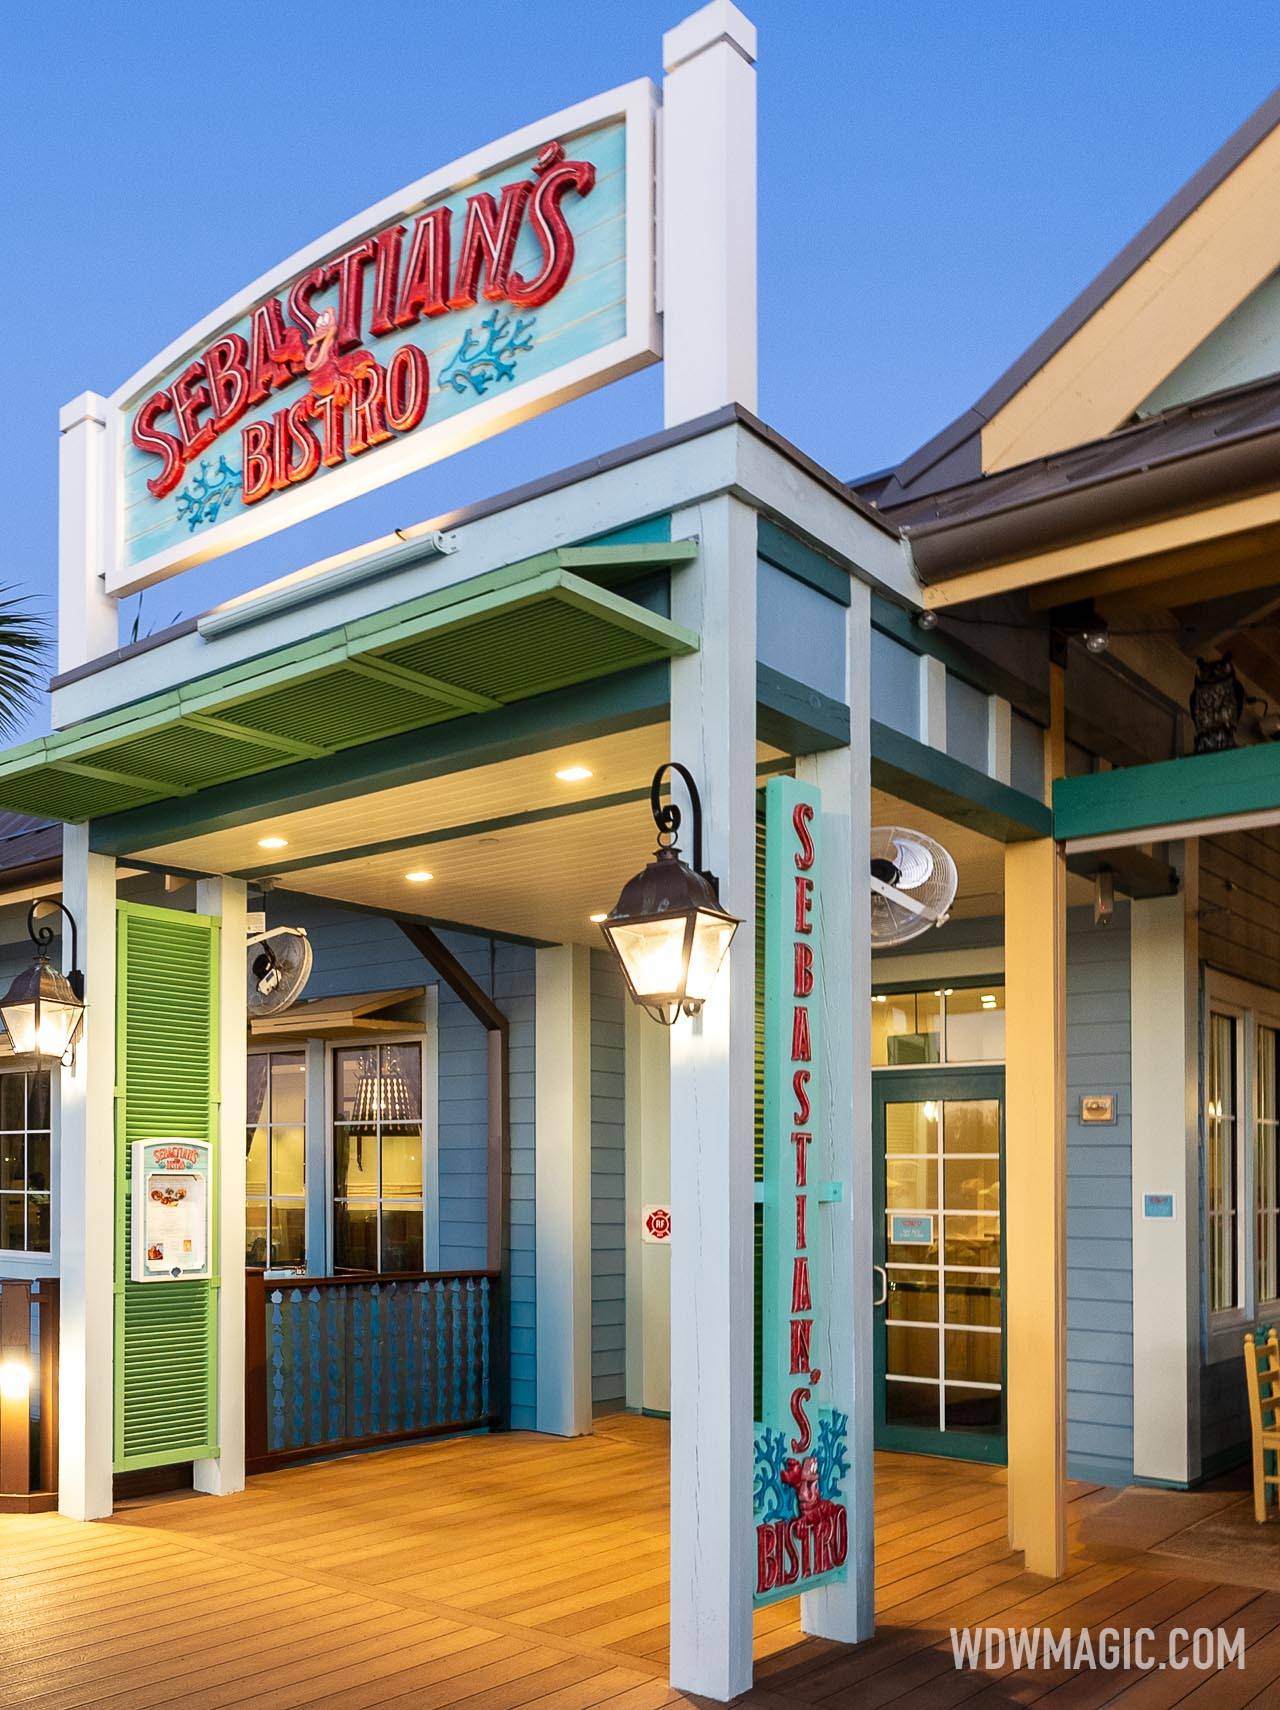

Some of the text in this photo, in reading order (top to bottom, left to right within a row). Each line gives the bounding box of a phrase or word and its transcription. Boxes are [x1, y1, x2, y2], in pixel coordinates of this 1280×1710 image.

[132, 141, 596, 499] SEBASTIAN'S
[241, 345, 430, 505] BISTRO
[757, 1504, 848, 1593] BISTRO
